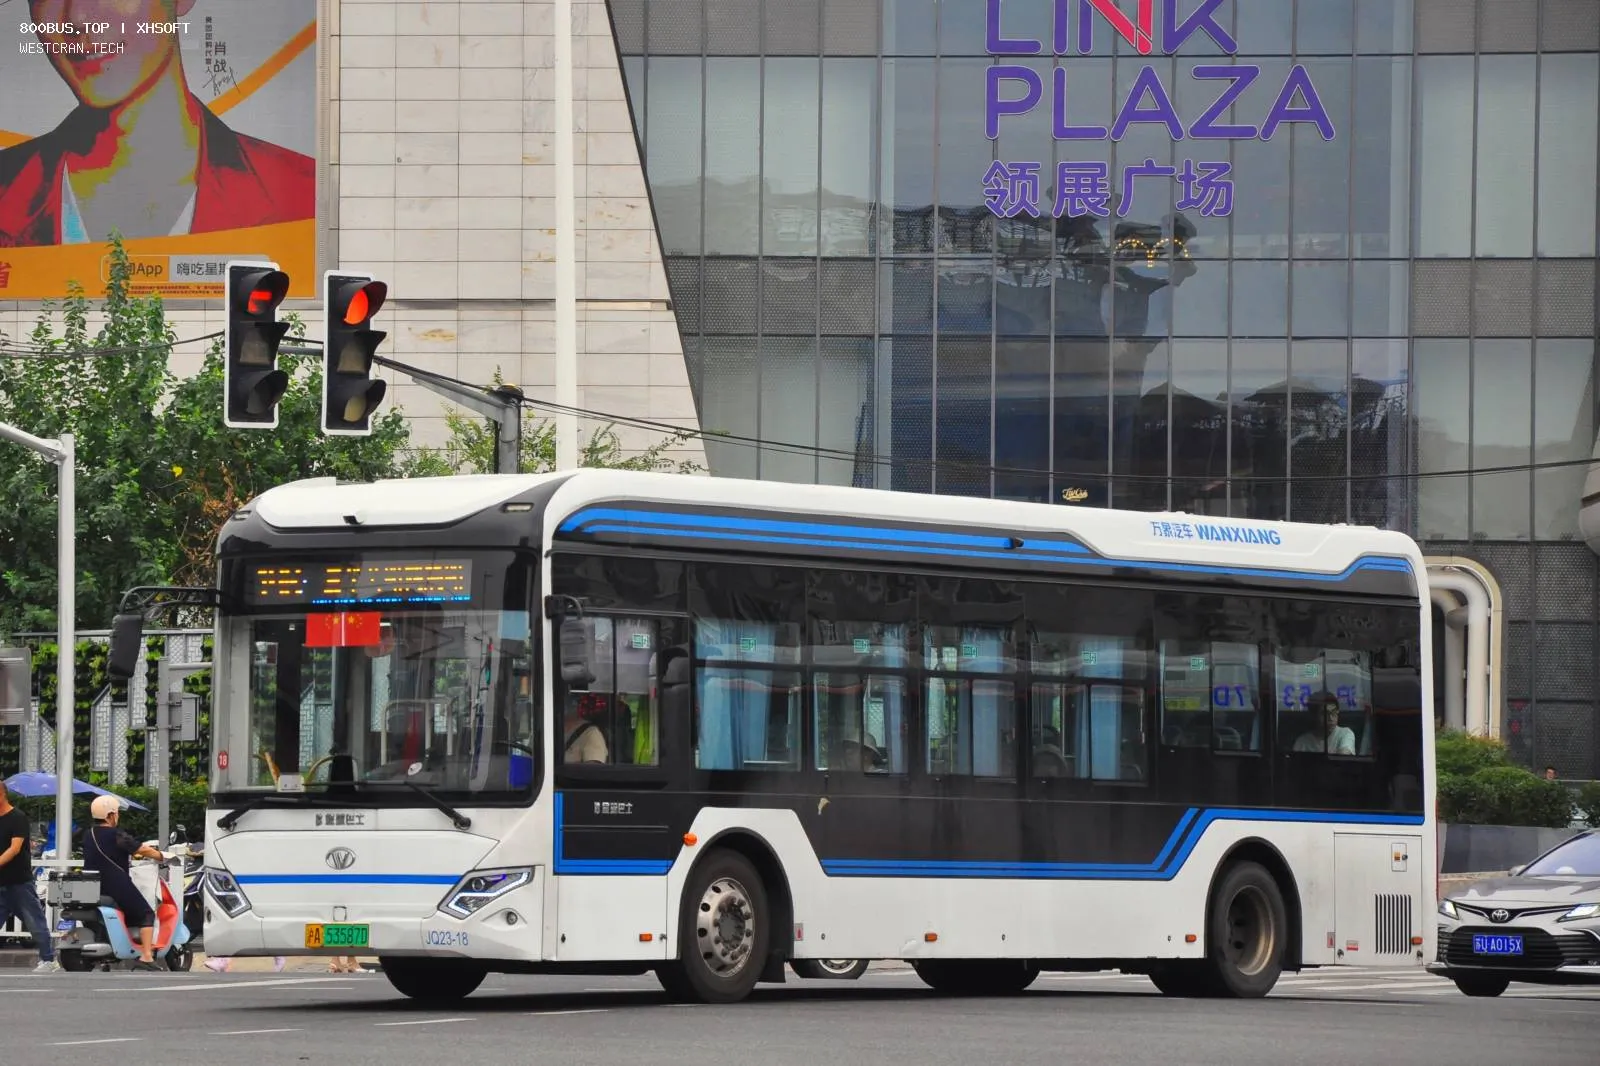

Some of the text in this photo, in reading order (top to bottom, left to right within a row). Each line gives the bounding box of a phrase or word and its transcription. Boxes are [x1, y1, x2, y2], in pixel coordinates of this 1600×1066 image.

[985, 0, 1238, 55] LINK
[213, 41, 227, 73] 肖战
[985, 65, 1335, 141] PLAZA
[982, 159, 1234, 218] 领展广场
[1150, 521, 1281, 546] 万象汽车 WANXIANG
[219, 754, 228, 767] 18
[426, 930, 469, 946] JQ23-18
